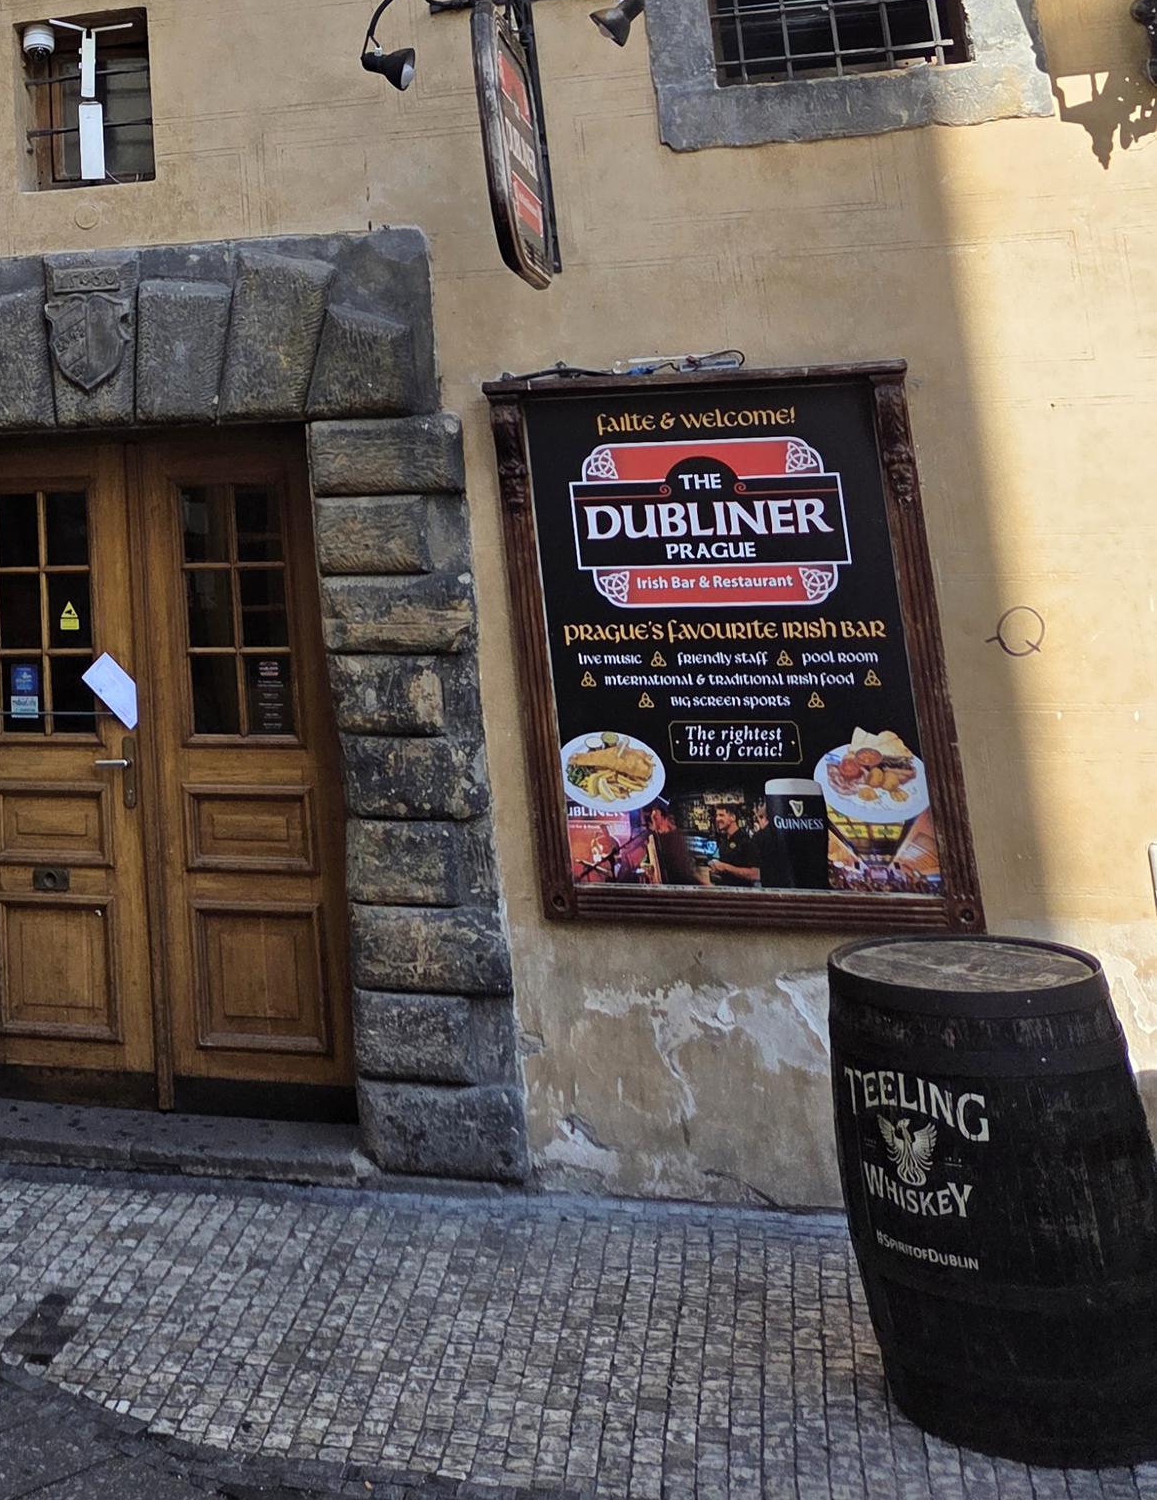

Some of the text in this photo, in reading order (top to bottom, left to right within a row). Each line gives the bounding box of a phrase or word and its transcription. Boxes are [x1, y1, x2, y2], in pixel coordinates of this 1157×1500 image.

[659, 410, 675, 430] &
[678, 473, 722, 490] THE
[583, 498, 834, 540] DUBLINER
[665, 541, 756, 559] PRAGUE
[636, 573, 793, 589] Irish Bar & Restaurant
[696, 675, 706, 686] &
[685, 726, 782, 744] The rightest
[688, 741, 783, 760] bit of craic!
[774, 815, 824, 830] GUINNESS
[844, 1066, 990, 1142] TEELING
[863, 1161, 973, 1218] WHISKEY
